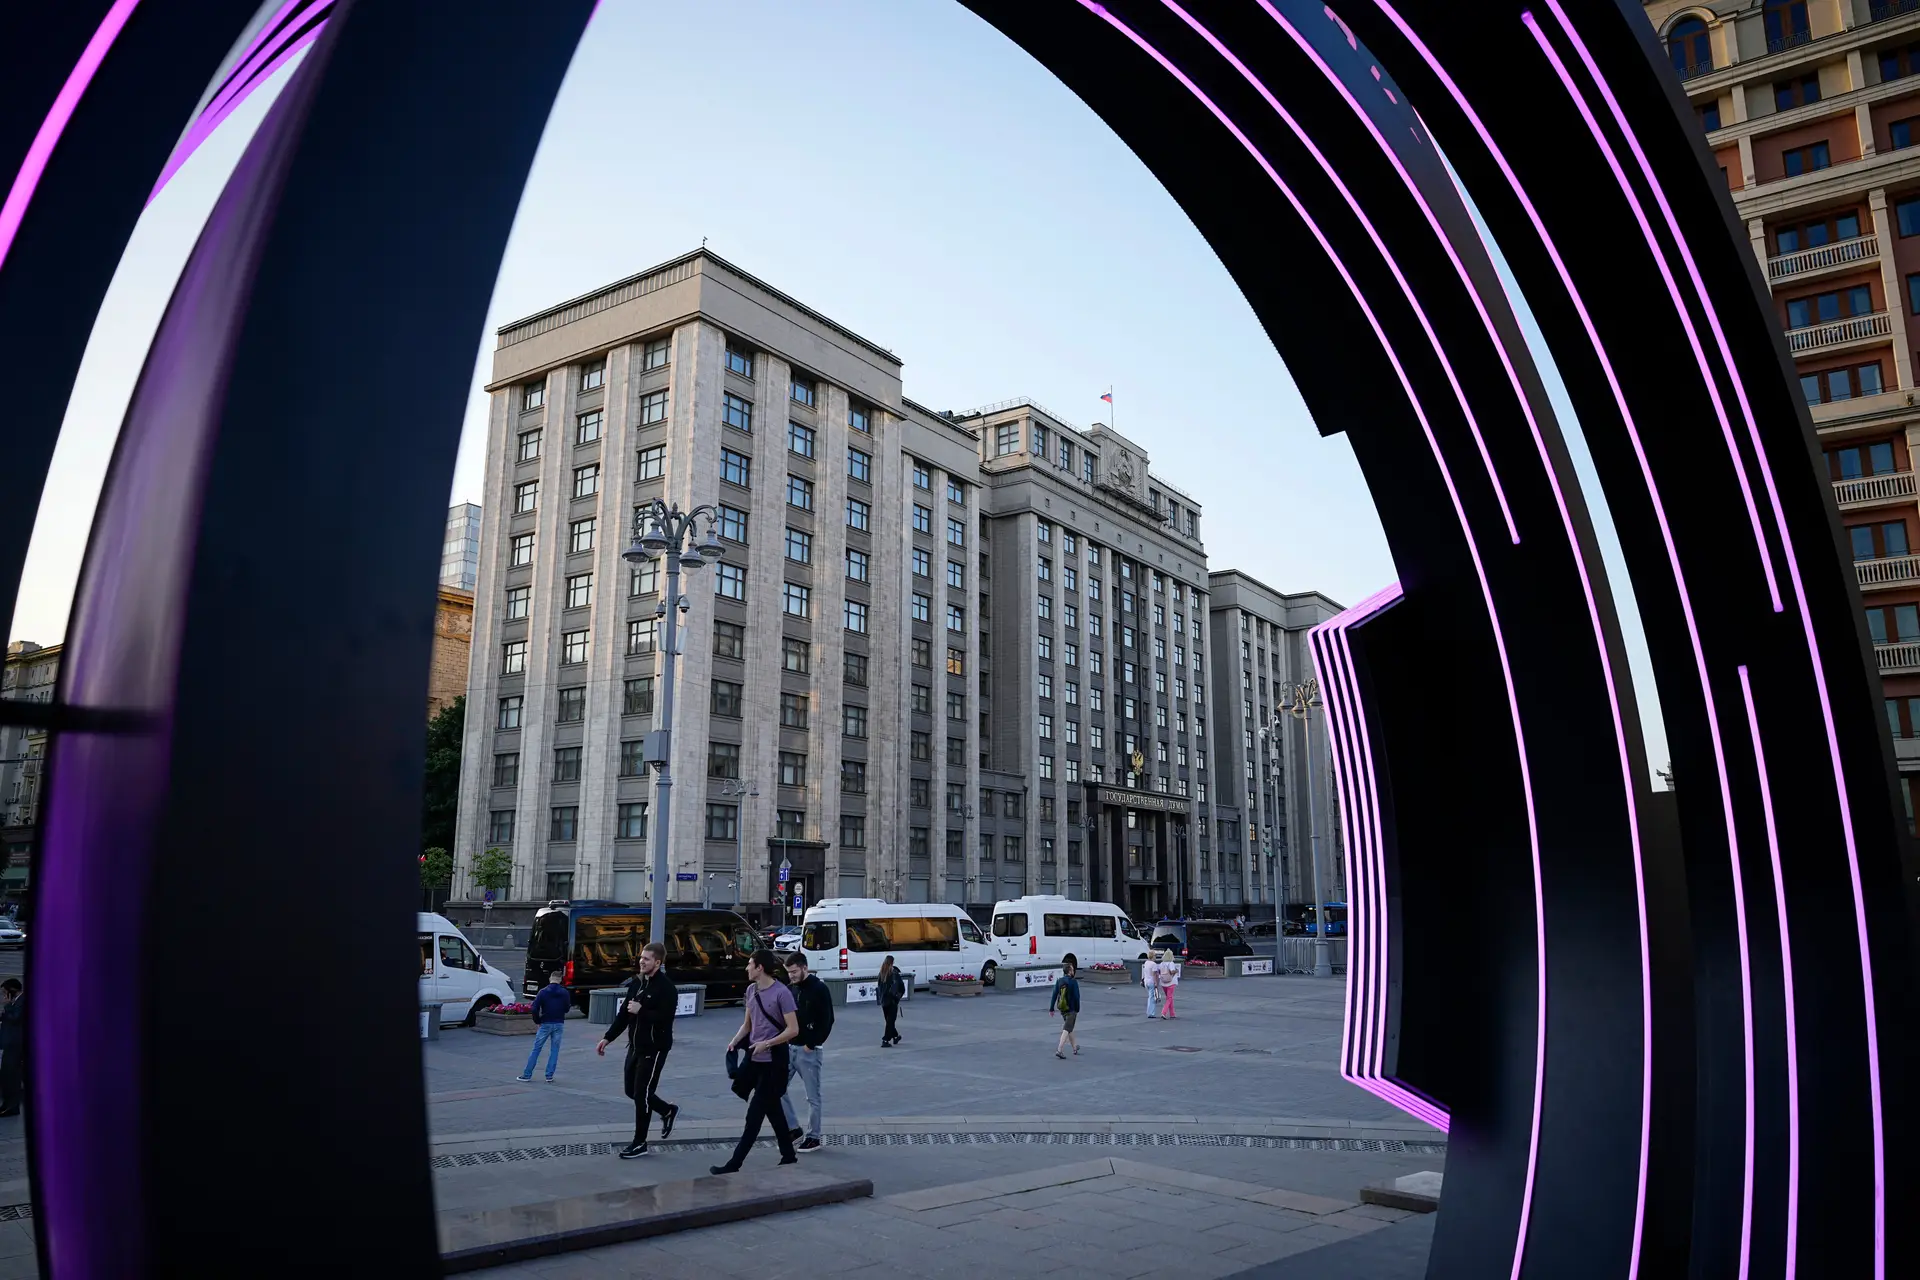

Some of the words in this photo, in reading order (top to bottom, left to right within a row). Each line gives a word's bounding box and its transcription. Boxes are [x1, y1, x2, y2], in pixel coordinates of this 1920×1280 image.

[1105, 791, 1164, 807] ГОСУДАРСТВЕННАЯ
[1168, 800, 1184, 810] ДУМА
[795, 897, 801, 907] P
